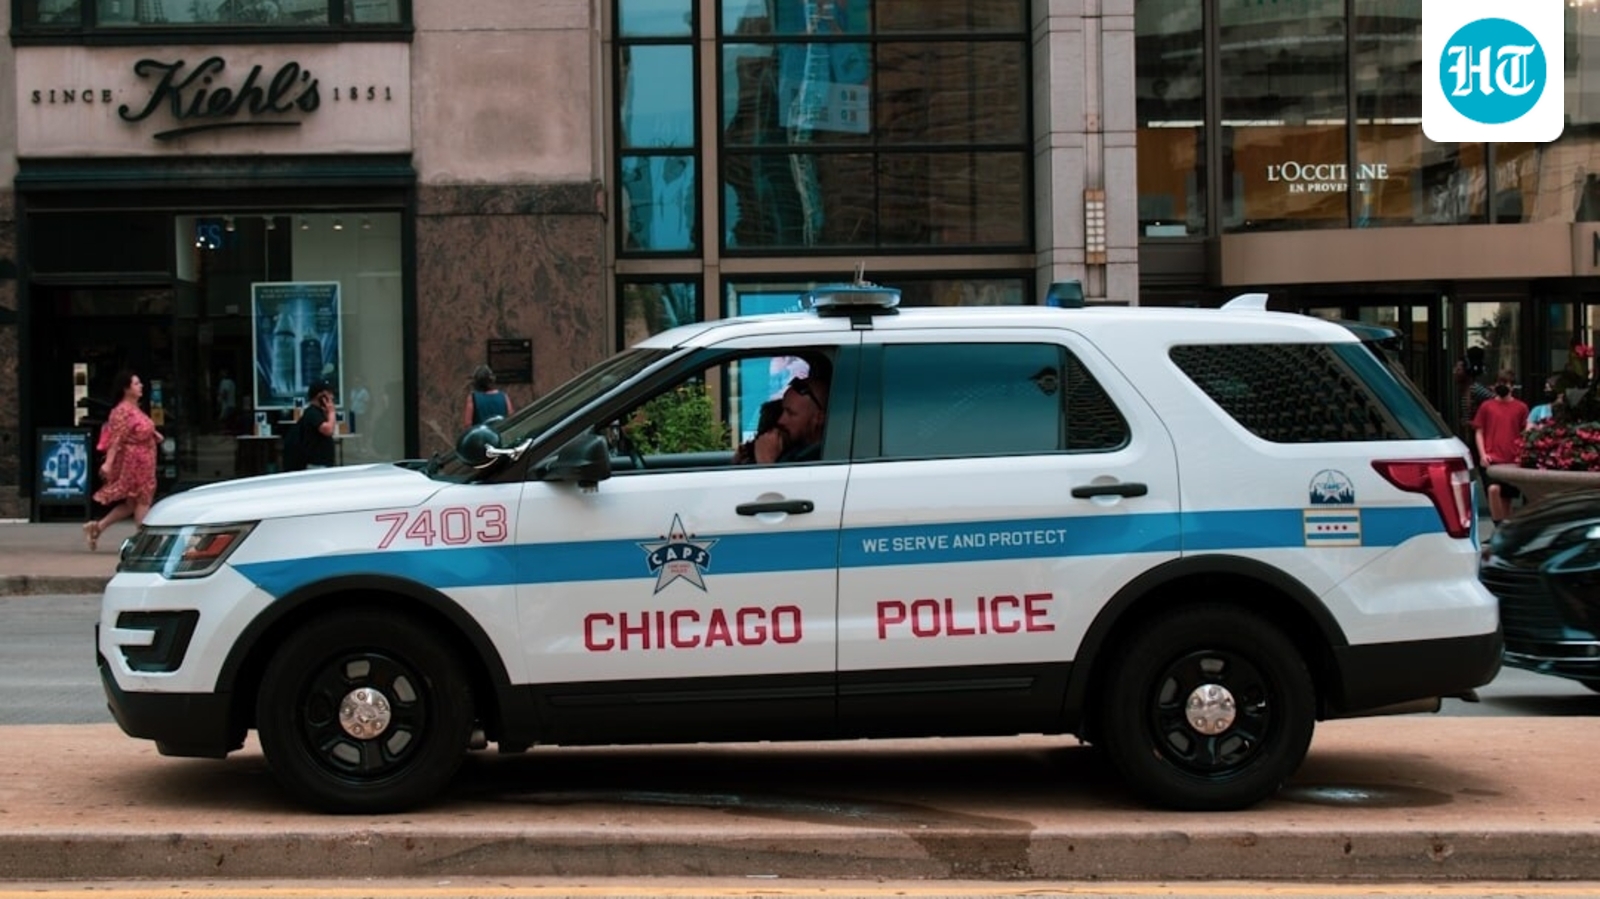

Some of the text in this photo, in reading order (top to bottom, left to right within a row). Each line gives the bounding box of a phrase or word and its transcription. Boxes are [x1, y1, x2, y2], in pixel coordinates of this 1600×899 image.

[32, 56, 393, 123] SINCE Kiehl's 1851
[1289, 183, 1365, 193] EN PROVENE
[374, 504, 508, 549] 7403
[862, 529, 1067, 553] WE SERVE AND PROTECT
[651, 547, 706, 565] CAPS
[584, 593, 1055, 651] CHICAGO POLICE
